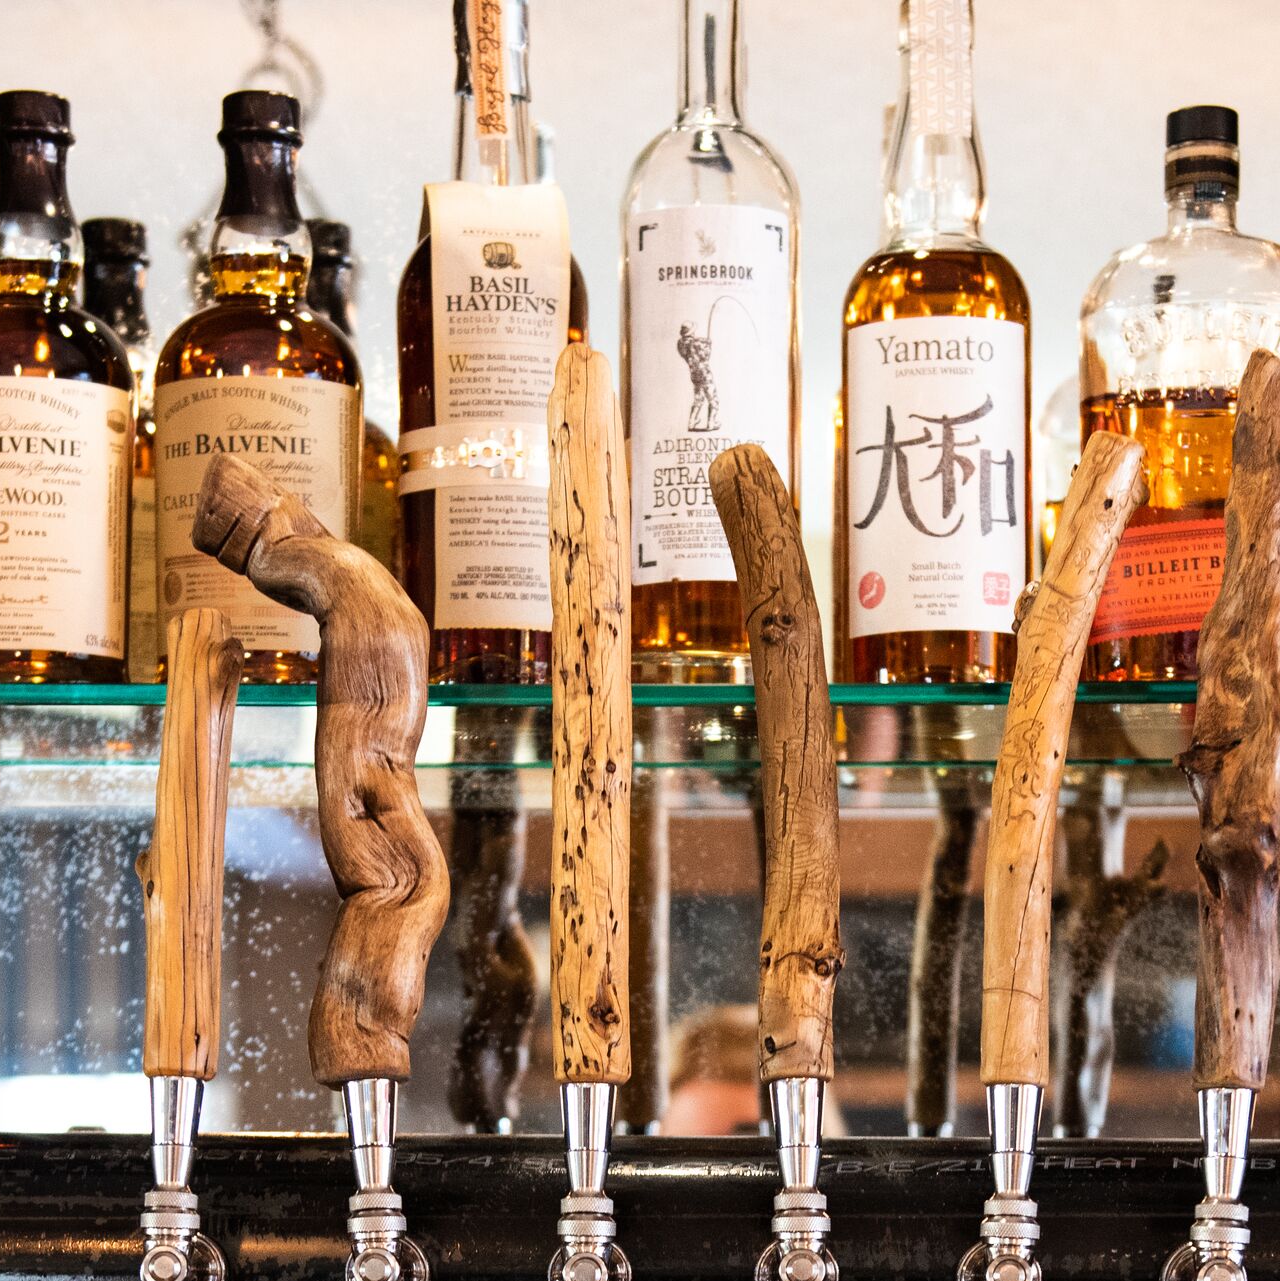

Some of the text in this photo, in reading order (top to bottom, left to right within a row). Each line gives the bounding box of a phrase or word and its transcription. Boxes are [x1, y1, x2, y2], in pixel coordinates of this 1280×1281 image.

[658, 265, 753, 281] SPRINGBROOK
[470, 276, 534, 294] BASIL
[446, 295, 556, 315] HAYDEN'S
[449, 315, 554, 329] Kentucky Straight
[449, 327, 551, 338] Bourbon Whiskey
[876, 335, 994, 365] Yamato
[486, 364, 516, 374] distilling
[895, 367, 975, 378] JAPANESE WHISKY
[40, 394, 81, 419] WHISKY
[192, 388, 218, 402] MALT
[222, 387, 266, 400] SCOTCH
[270, 393, 311, 417] WHISKY
[225, 413, 281, 431] Distilled
[164, 433, 312, 460] THE BALVENIE
[273, 476, 312, 484] SCOTLAND
[487, 507, 518, 515] Straight
[449, 517, 481, 525] WHISKEY
[449, 540, 517, 548] AMERICA'S frontier
[912, 562, 934, 571] Small
[1123, 557, 1200, 578] BULLEIT
[909, 572, 964, 581] Natural Color
[1138, 573, 1213, 587] FRONTIER
[1162, 590, 1215, 601] STRAIGHT
